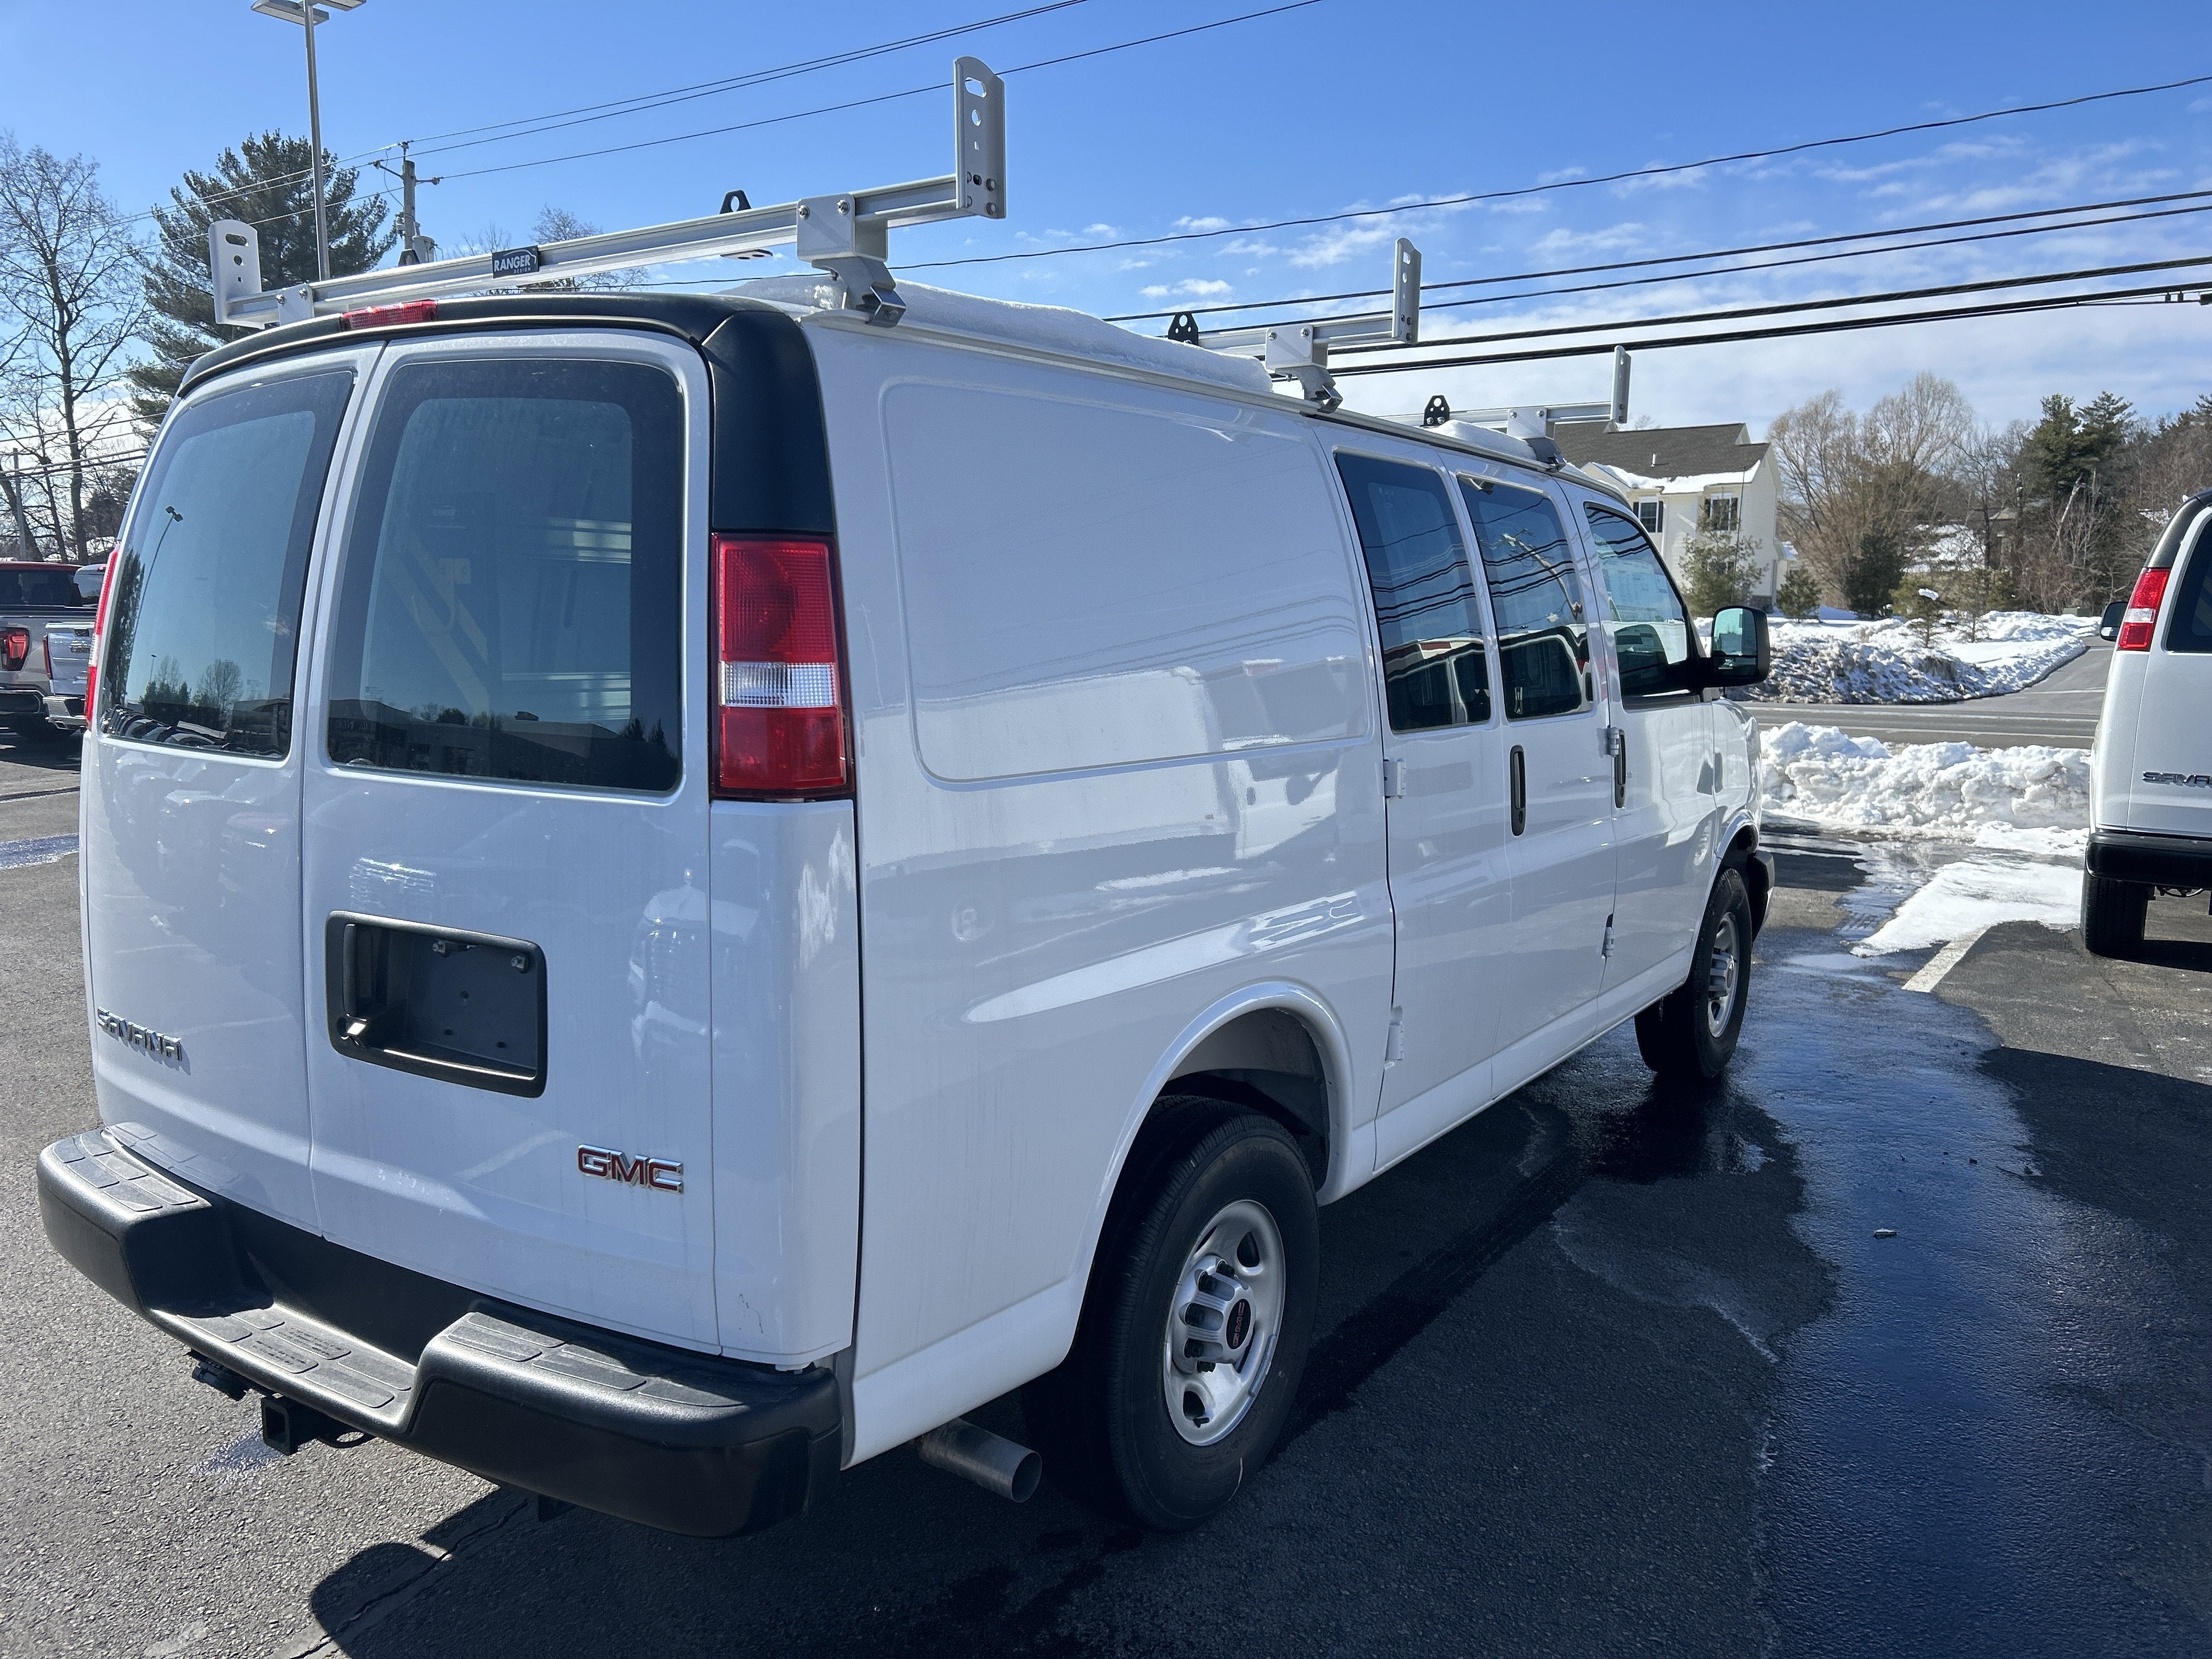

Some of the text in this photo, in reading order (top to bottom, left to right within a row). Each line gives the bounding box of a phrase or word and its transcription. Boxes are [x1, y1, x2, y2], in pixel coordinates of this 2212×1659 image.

[494, 254, 531, 272] RANGER
[2142, 771, 2212, 784] SAVA
[578, 1144, 683, 1194] GMC
[1232, 1302, 1245, 1346] GMC
